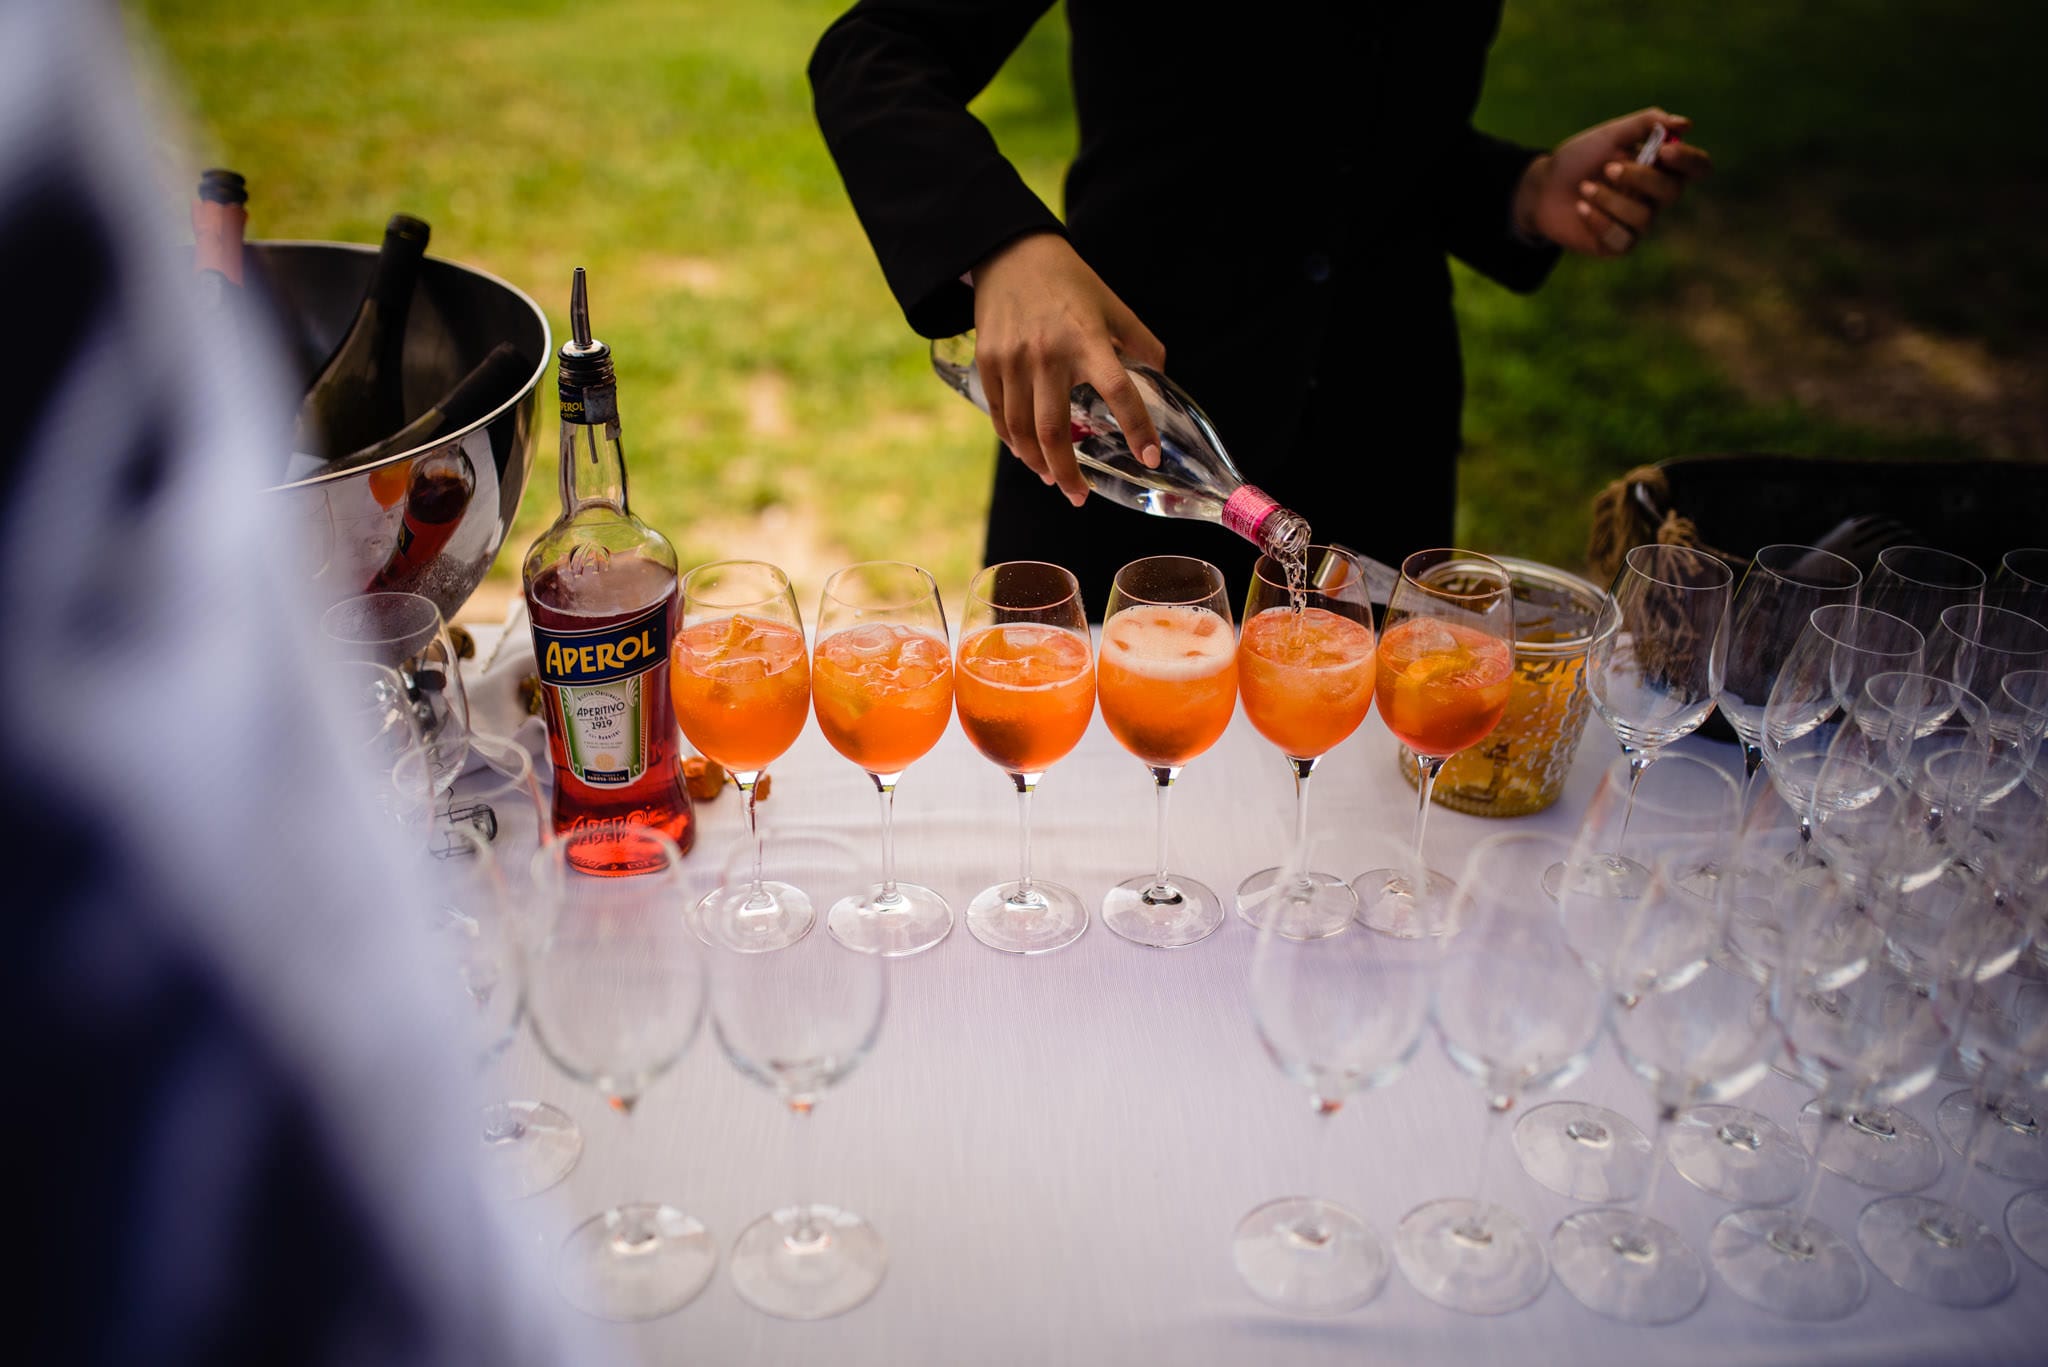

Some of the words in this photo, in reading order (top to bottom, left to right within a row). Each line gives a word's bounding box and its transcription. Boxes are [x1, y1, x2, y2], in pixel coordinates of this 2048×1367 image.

[546, 630, 656, 676] APEROL
[576, 701, 625, 717] APERITIVO
[591, 719, 613, 730] 1919
